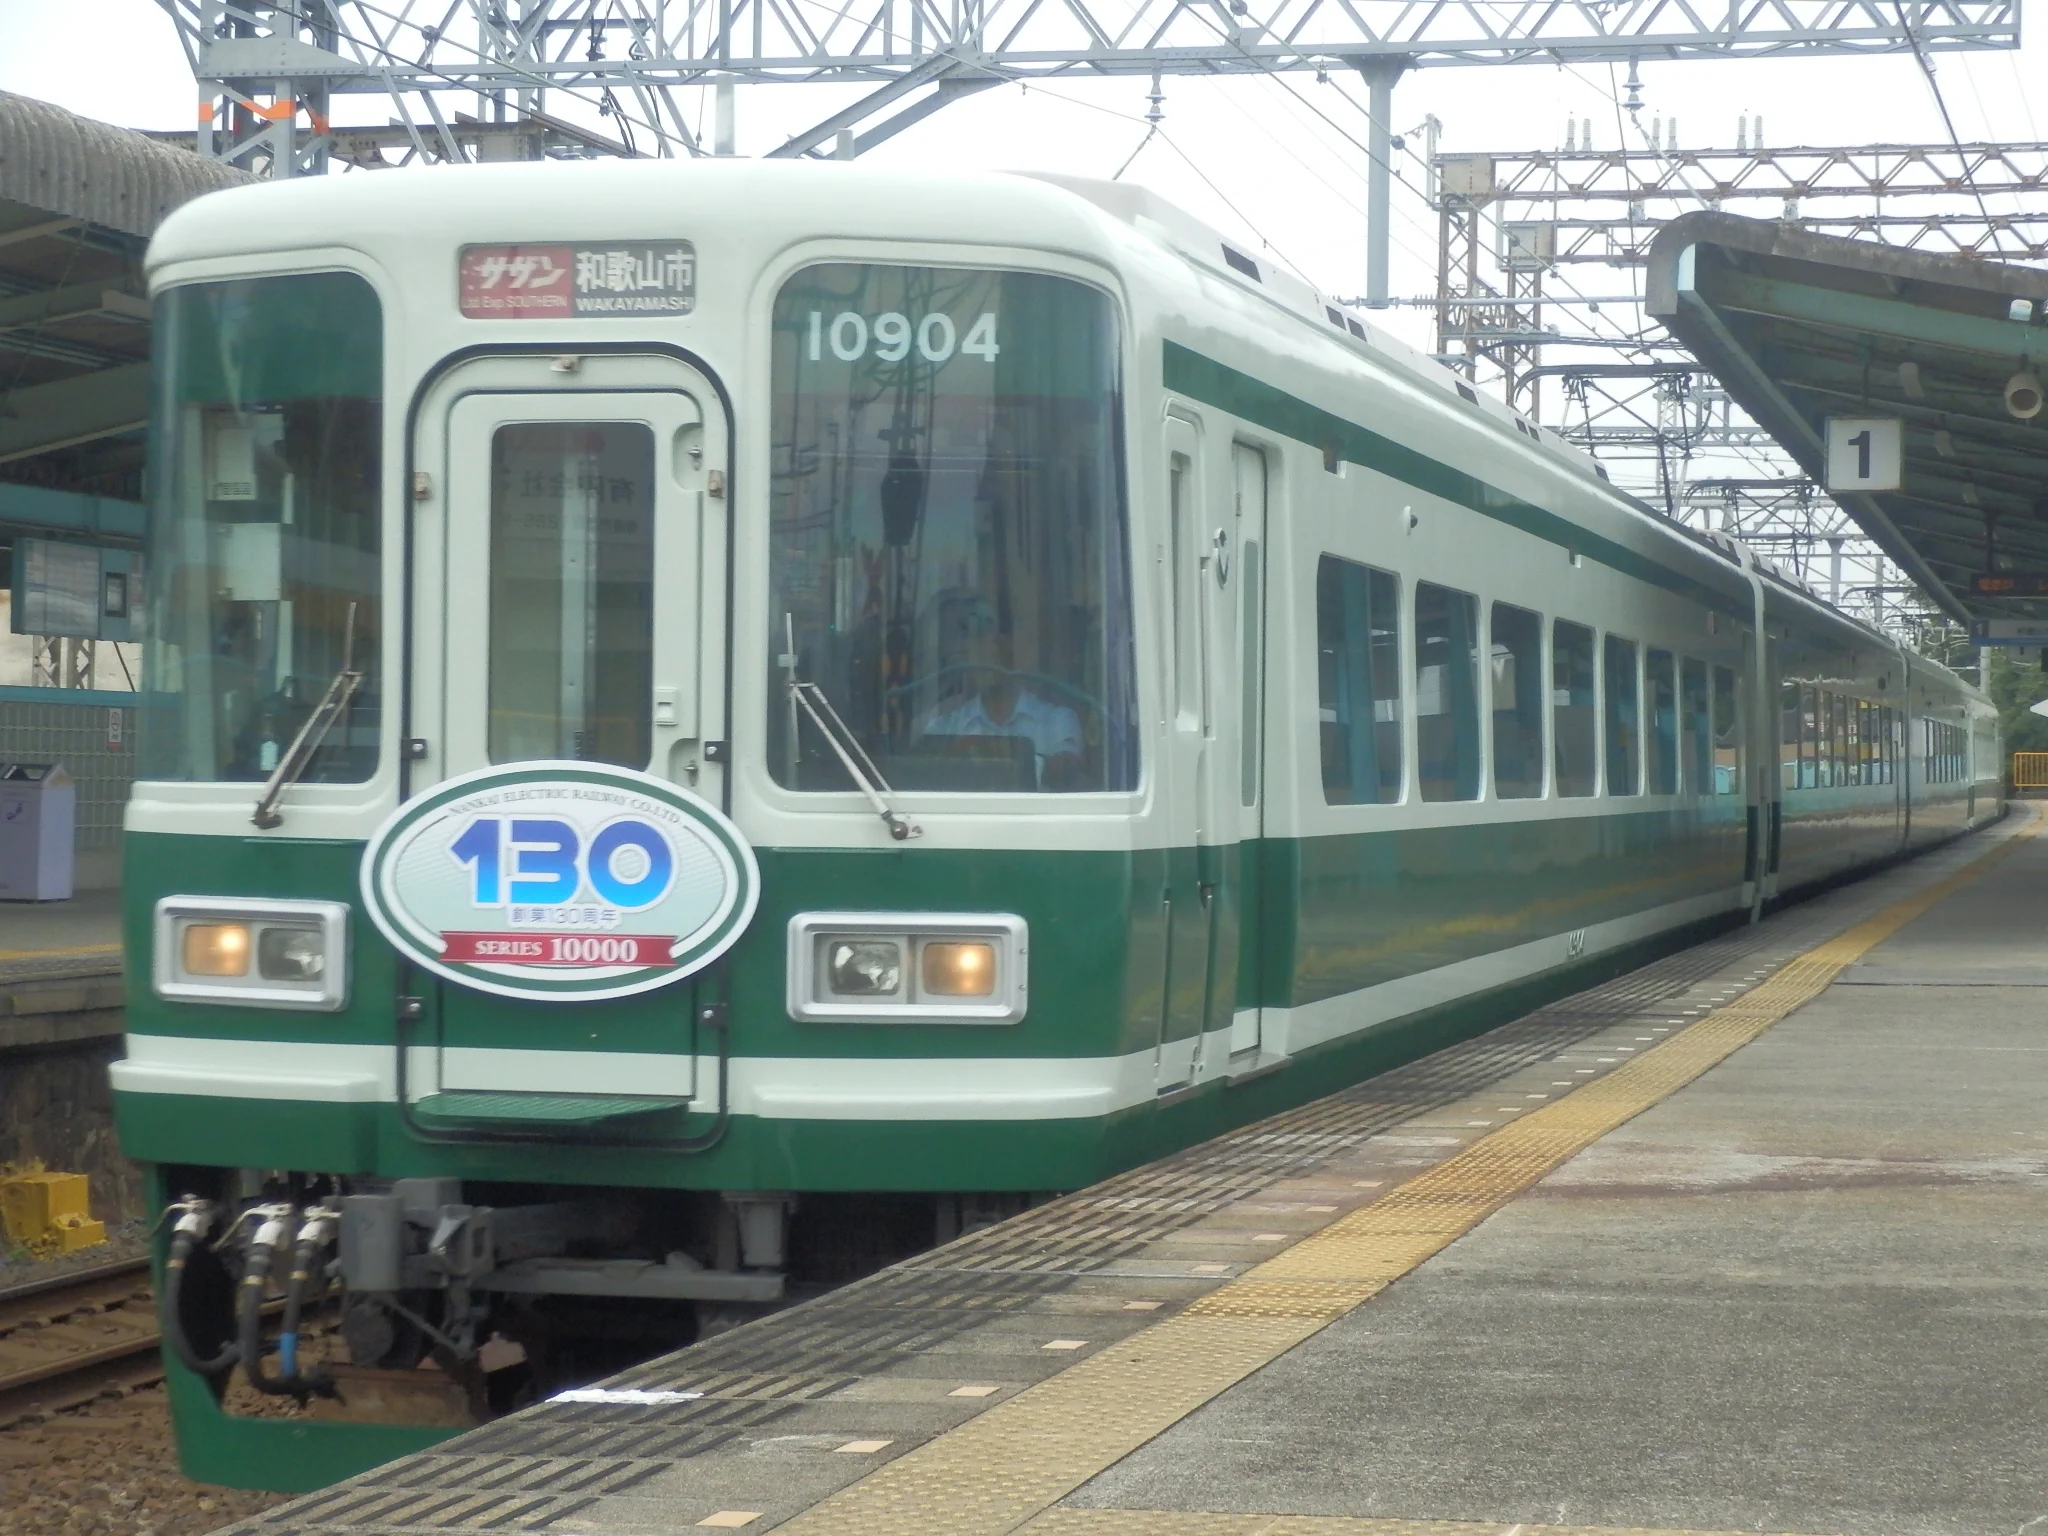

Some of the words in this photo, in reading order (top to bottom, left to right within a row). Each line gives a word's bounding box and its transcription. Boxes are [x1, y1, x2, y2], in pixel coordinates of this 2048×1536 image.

[478, 256, 567, 289] サザン
[575, 249, 694, 293] 和歌山市
[809, 311, 1000, 363] 10904
[1847, 430, 1871, 479] 1
[449, 794, 499, 814] NANKAI
[503, 788, 570, 802] ELECTRIC
[572, 789, 630, 806] RAILWAY
[448, 818, 673, 908] 130
[511, 907, 618, 925] 創業130周年
[475, 940, 543, 956] SERIES
[550, 937, 639, 963] 10000
